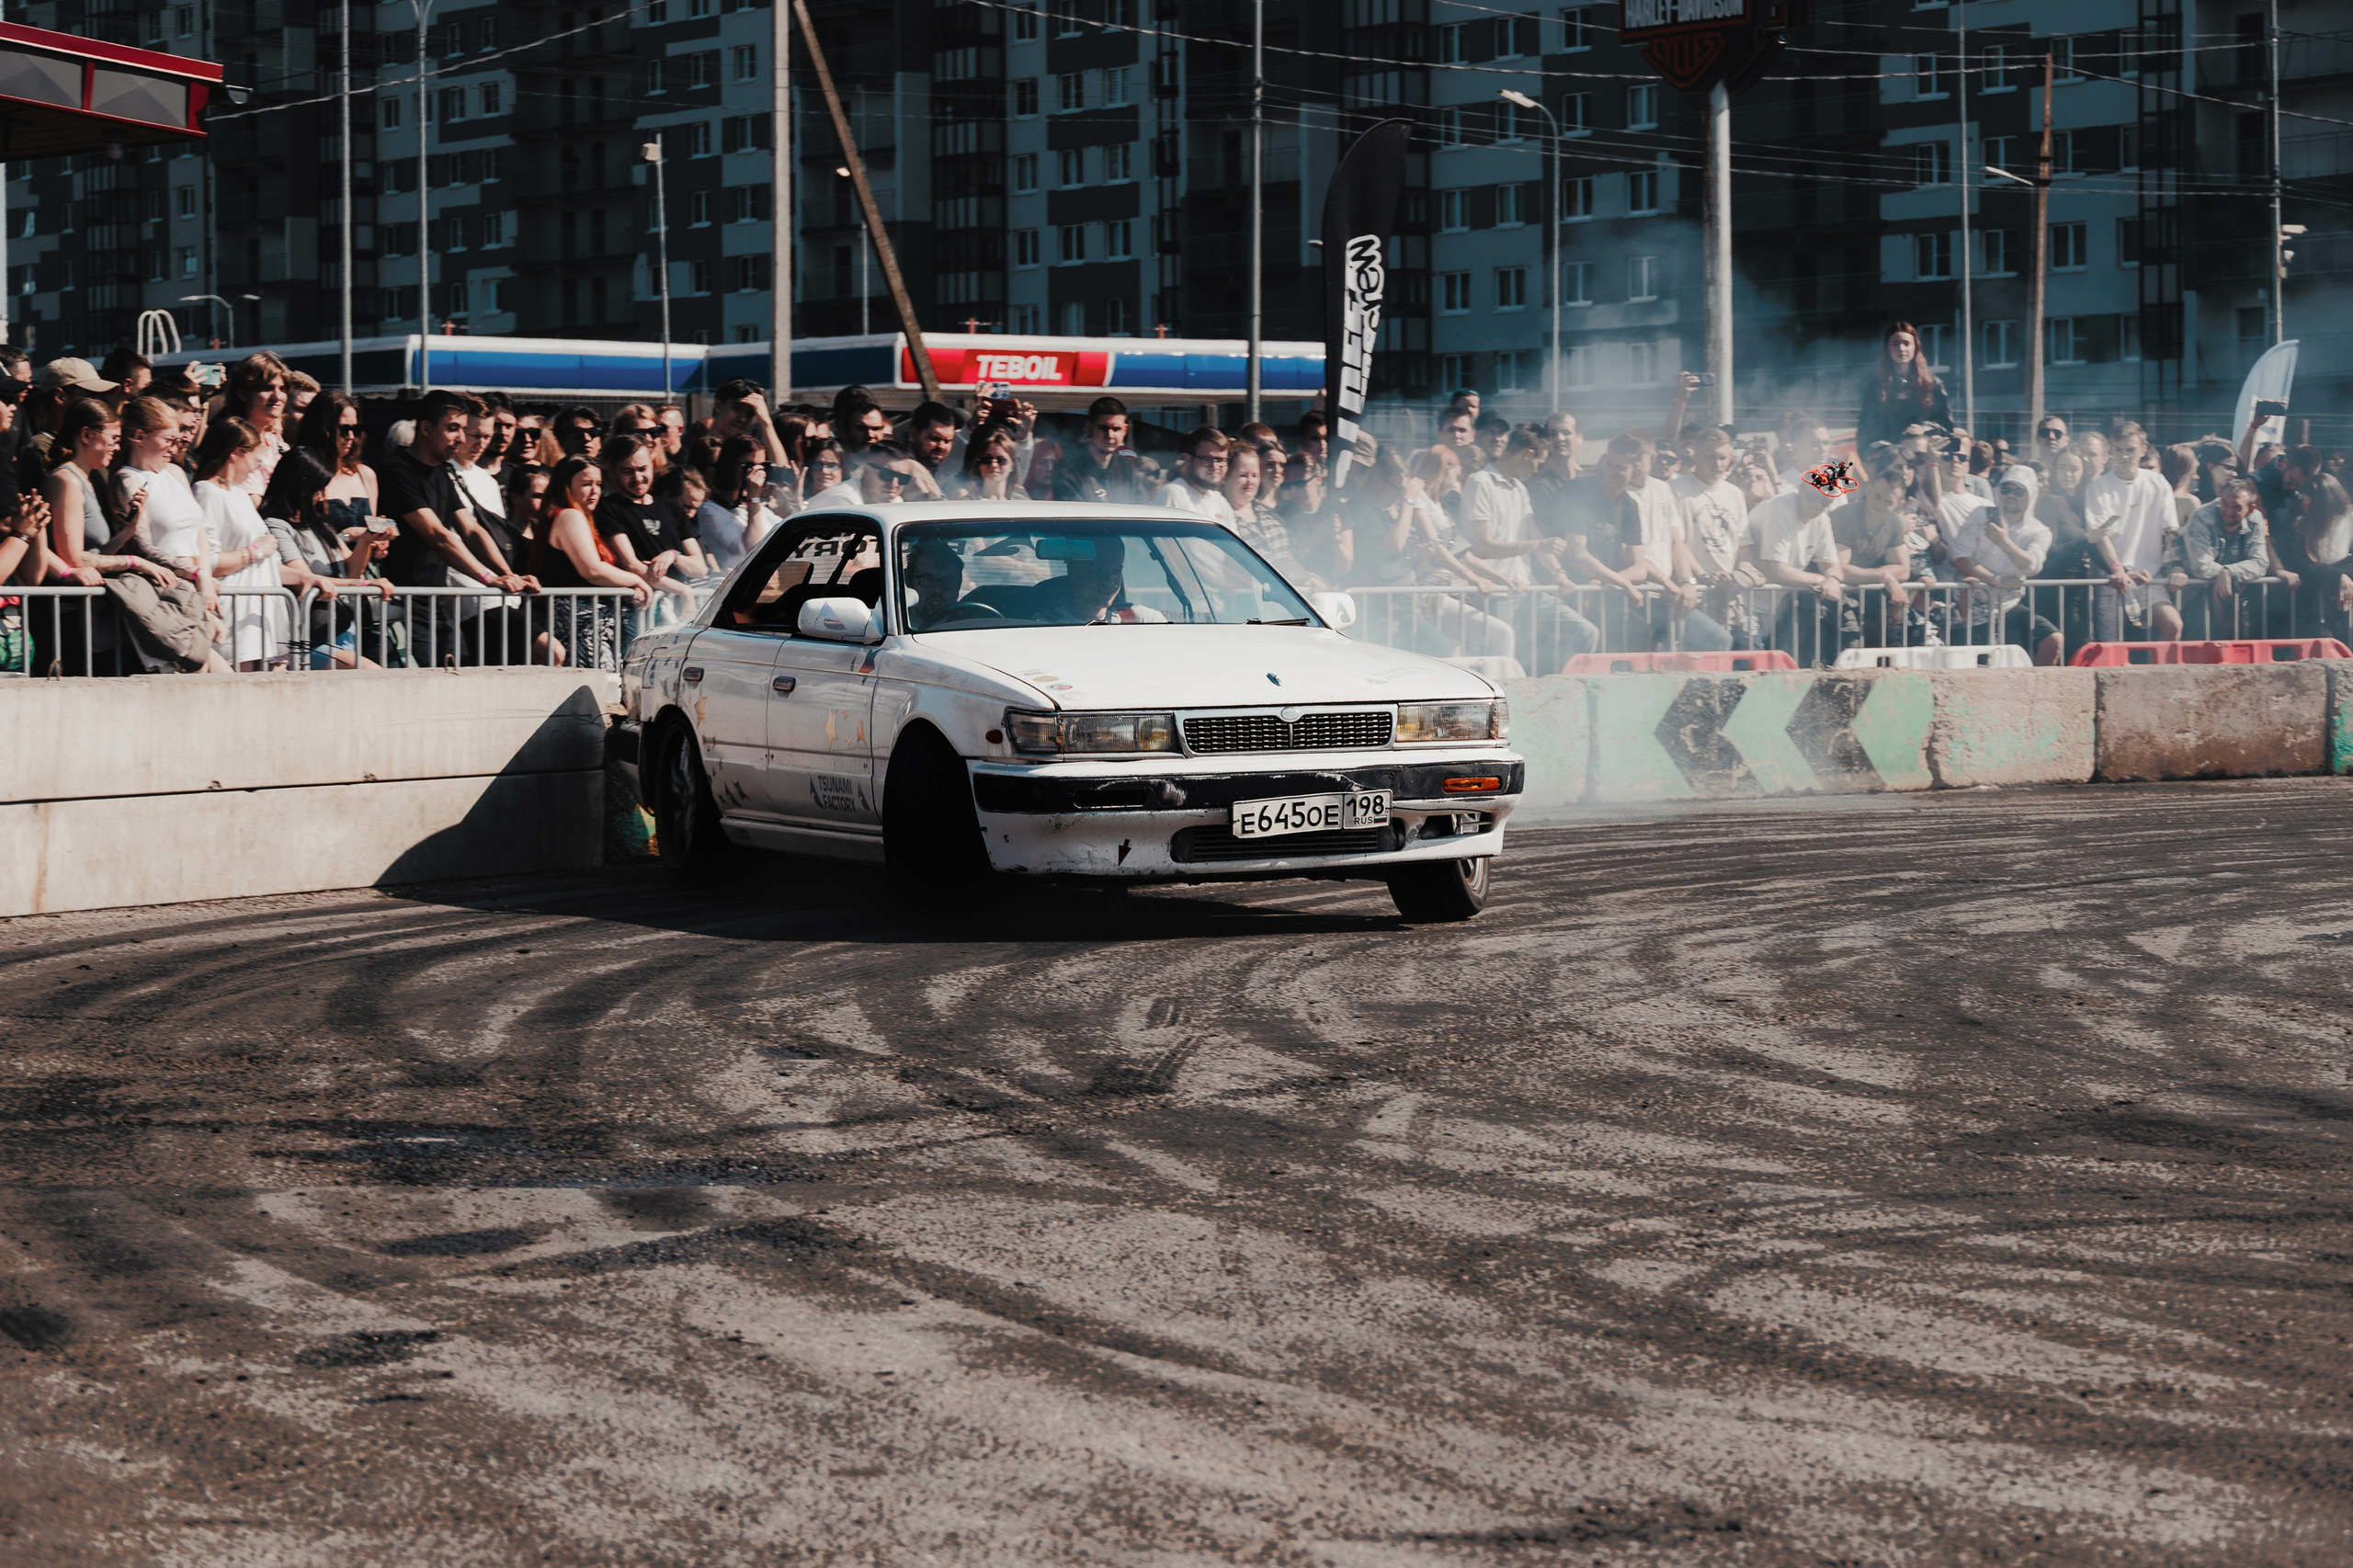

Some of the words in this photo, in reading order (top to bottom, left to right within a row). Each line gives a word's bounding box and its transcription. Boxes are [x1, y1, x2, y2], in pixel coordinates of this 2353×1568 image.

[1651, 32, 1718, 76] CYCLES
[976, 354, 1063, 381] TEBOIL
[818, 775, 853, 795] TSUNAMI
[823, 794, 856, 813] FACTORY
[1241, 801, 1339, 835] E645OE
[1347, 795, 1385, 817] 198
[1354, 816, 1373, 825] RUS
